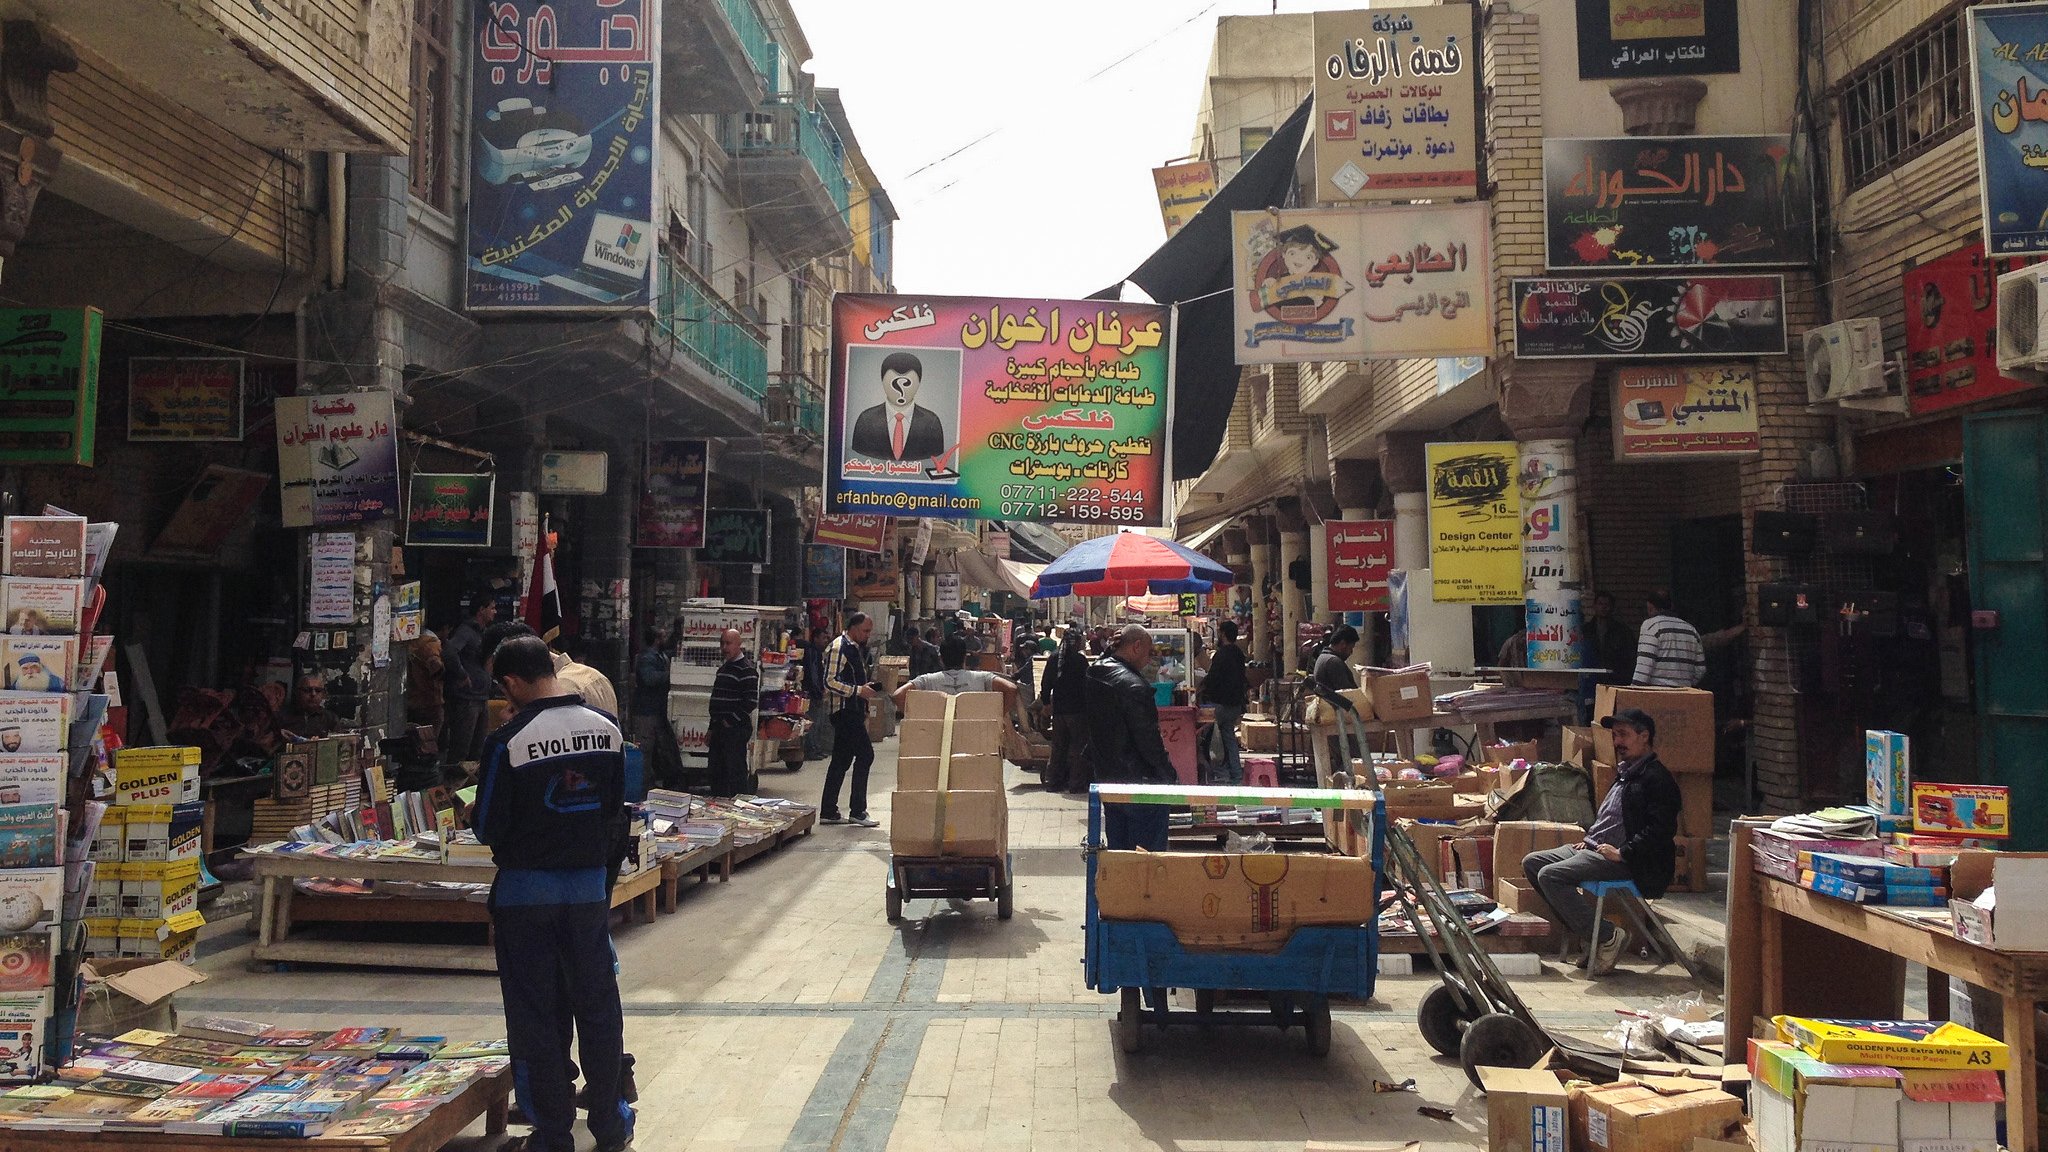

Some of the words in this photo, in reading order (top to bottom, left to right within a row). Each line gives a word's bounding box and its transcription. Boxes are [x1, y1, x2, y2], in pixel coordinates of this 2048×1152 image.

[1372, 13, 1413, 35] شركة
[1326, 37, 1403, 86] الرفاه
[1410, 36, 1462, 77] قمة
[1611, 46, 1660, 69] العراقي
[1664, 45, 1706, 64] للكتاب
[1993, 43, 2020, 61] AL
[1346, 86, 1393, 103] الحصرية
[1400, 85, 1442, 100] للوكالات
[1360, 105, 1392, 129] زفاف
[1402, 103, 1449, 127] بطاقات
[1425, 138, 1455, 159] دعوة
[1563, 152, 1699, 209] الحوراء
[1704, 151, 1746, 207] دار
[481, 204, 574, 268] المكتبية
[594, 244, 636, 270] Windows
[1365, 242, 1467, 288] الطابعي
[863, 304, 936, 341] فلكس
[961, 306, 1060, 350] اخوان
[1068, 309, 1163, 354] عرفان
[1007, 357, 1047, 379] كبيرة
[1049, 356, 1097, 382] بأحجام
[1099, 359, 1141, 381] طباعة
[985, 381, 1051, 402] الانتخابية
[1053, 384, 1111, 405] الدعايات
[1113, 387, 1156, 409] طباعة
[312, 398, 355, 420] مكتبة
[1671, 388, 1749, 426] المتنبي
[1022, 408, 1115, 431] فلكس
[329, 422, 363, 443] علوم
[367, 421, 388, 441] دار
[988, 433, 1024, 450] CNC
[1026, 433, 1060, 454] بارزة
[1062, 436, 1105, 455] حروف
[1109, 437, 1152, 458] تقطيع
[1009, 458, 1071, 481] بوسترات
[1082, 459, 1129, 482] كارتات
[1448, 467, 1499, 488] القمة
[836, 491, 980, 510] erfanbro@gmail.com
[1000, 484, 1144, 504] 07711-222-544
[1001, 502, 1144, 521] 07712-159-595
[1492, 503, 1507, 513] 16
[1440, 532, 1475, 542] Design
[1479, 531, 1513, 541] Center
[1335, 550, 1387, 569] فورية
[685, 619, 717, 634] موبايل
[528, 735, 611, 760] EVOLUTION
[120, 772, 178, 791] GOLDEN
[131, 786, 170, 801] PLUS
[172, 826, 200, 847] GOLDEN
[177, 839, 197, 856] PLUS
[166, 882, 196, 905] GOLDEN
[172, 896, 192, 914] PLUS
[1847, 1043, 1884, 1052] GOLDEN
[1885, 1045, 1909, 1053] PLUS
[1910, 1046, 1934, 1054] Extra
[1935, 1048, 1962, 1056] White
[1860, 1052, 1883, 1060] Multi
[1885, 1054, 1921, 1063] Purpose
[1923, 1055, 1949, 1064] Paper
[1967, 1051, 1992, 1065] A3
